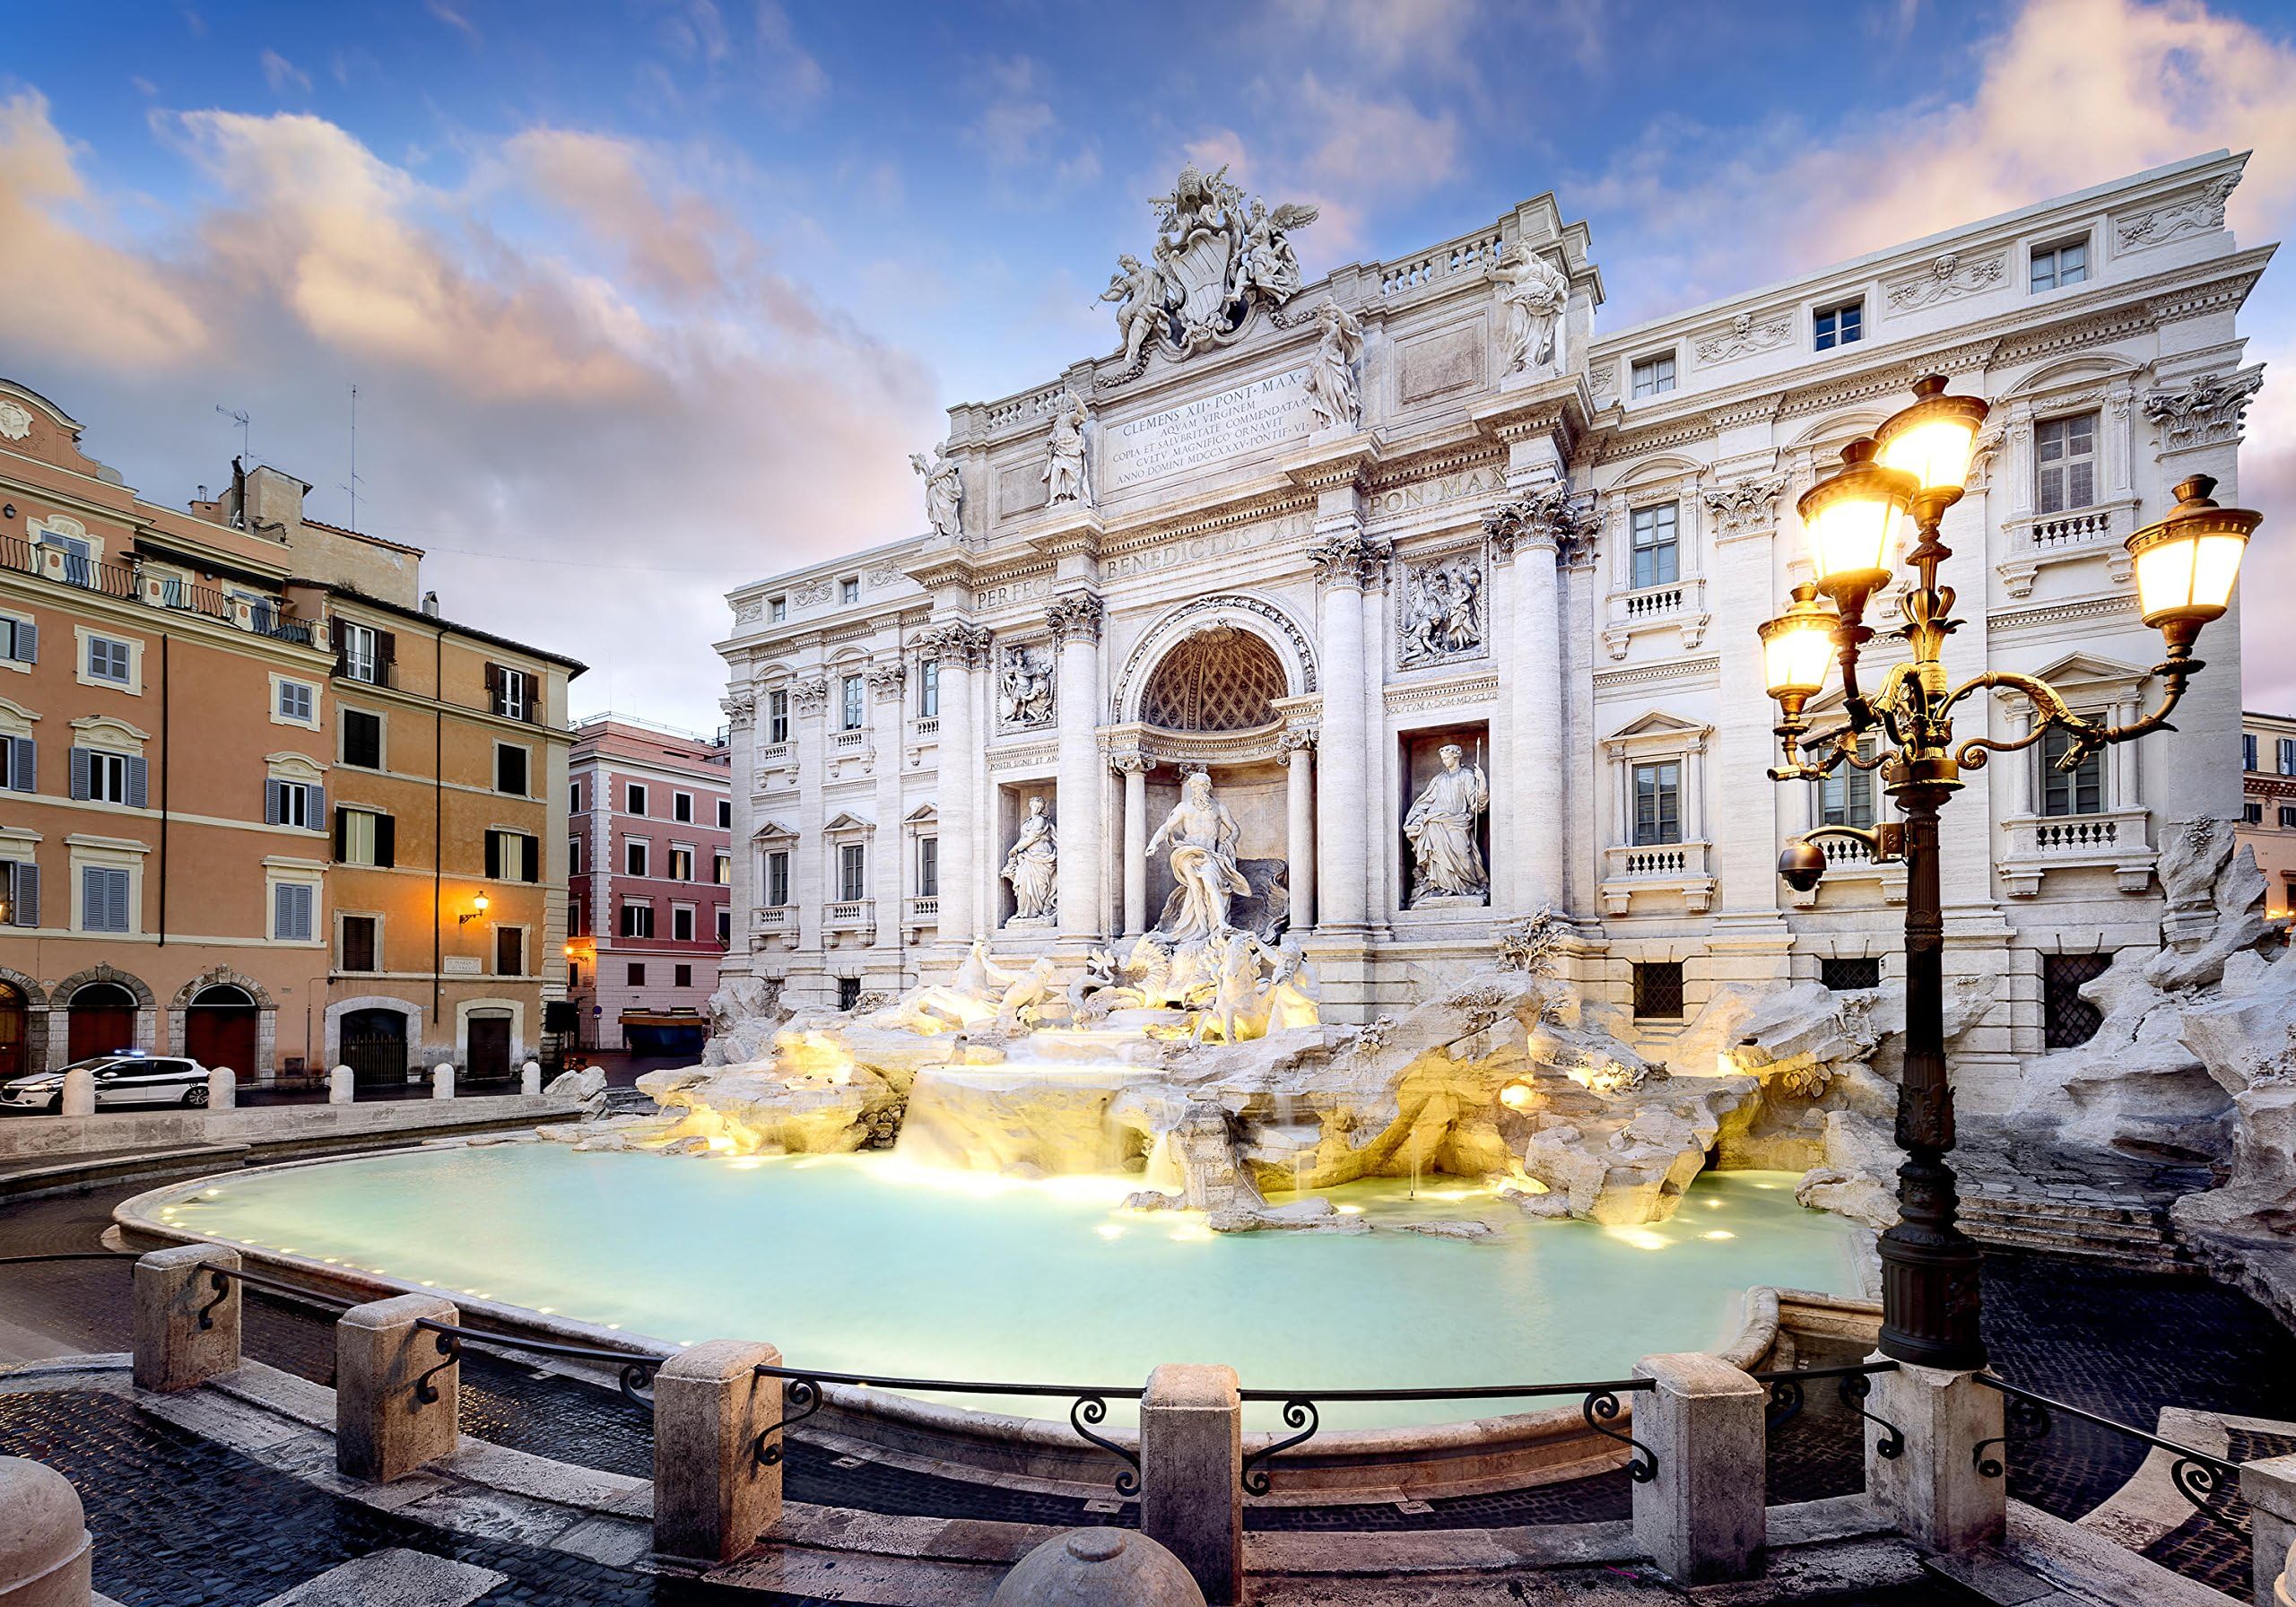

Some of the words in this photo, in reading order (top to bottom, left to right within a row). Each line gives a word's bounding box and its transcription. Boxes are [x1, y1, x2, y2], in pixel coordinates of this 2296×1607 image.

[1112, 448, 1140, 463] COPIA
[1144, 443, 1155, 454] ET
[1158, 423, 1221, 449] SALVBRITATE
[1225, 395, 1309, 429] COMMENDATAM
[1123, 410, 1179, 437] CLEMENS
[1161, 419, 1196, 438] AQVAM
[1203, 400, 1255, 423] VIRGINEM
[1136, 450, 1166, 467] CVLTV
[1173, 433, 1230, 457] MAGNIFICO
[1234, 416, 1283, 438] ORNAVIT
[1117, 470, 1144, 485] ANNO
[1147, 458, 1183, 476] DOMINI
[978, 574, 1058, 609] PERFECI
[1107, 529, 1254, 579] BENEDICTVS
[1271, 512, 1316, 541] XIV
[1439, 464, 1507, 501] MAX
